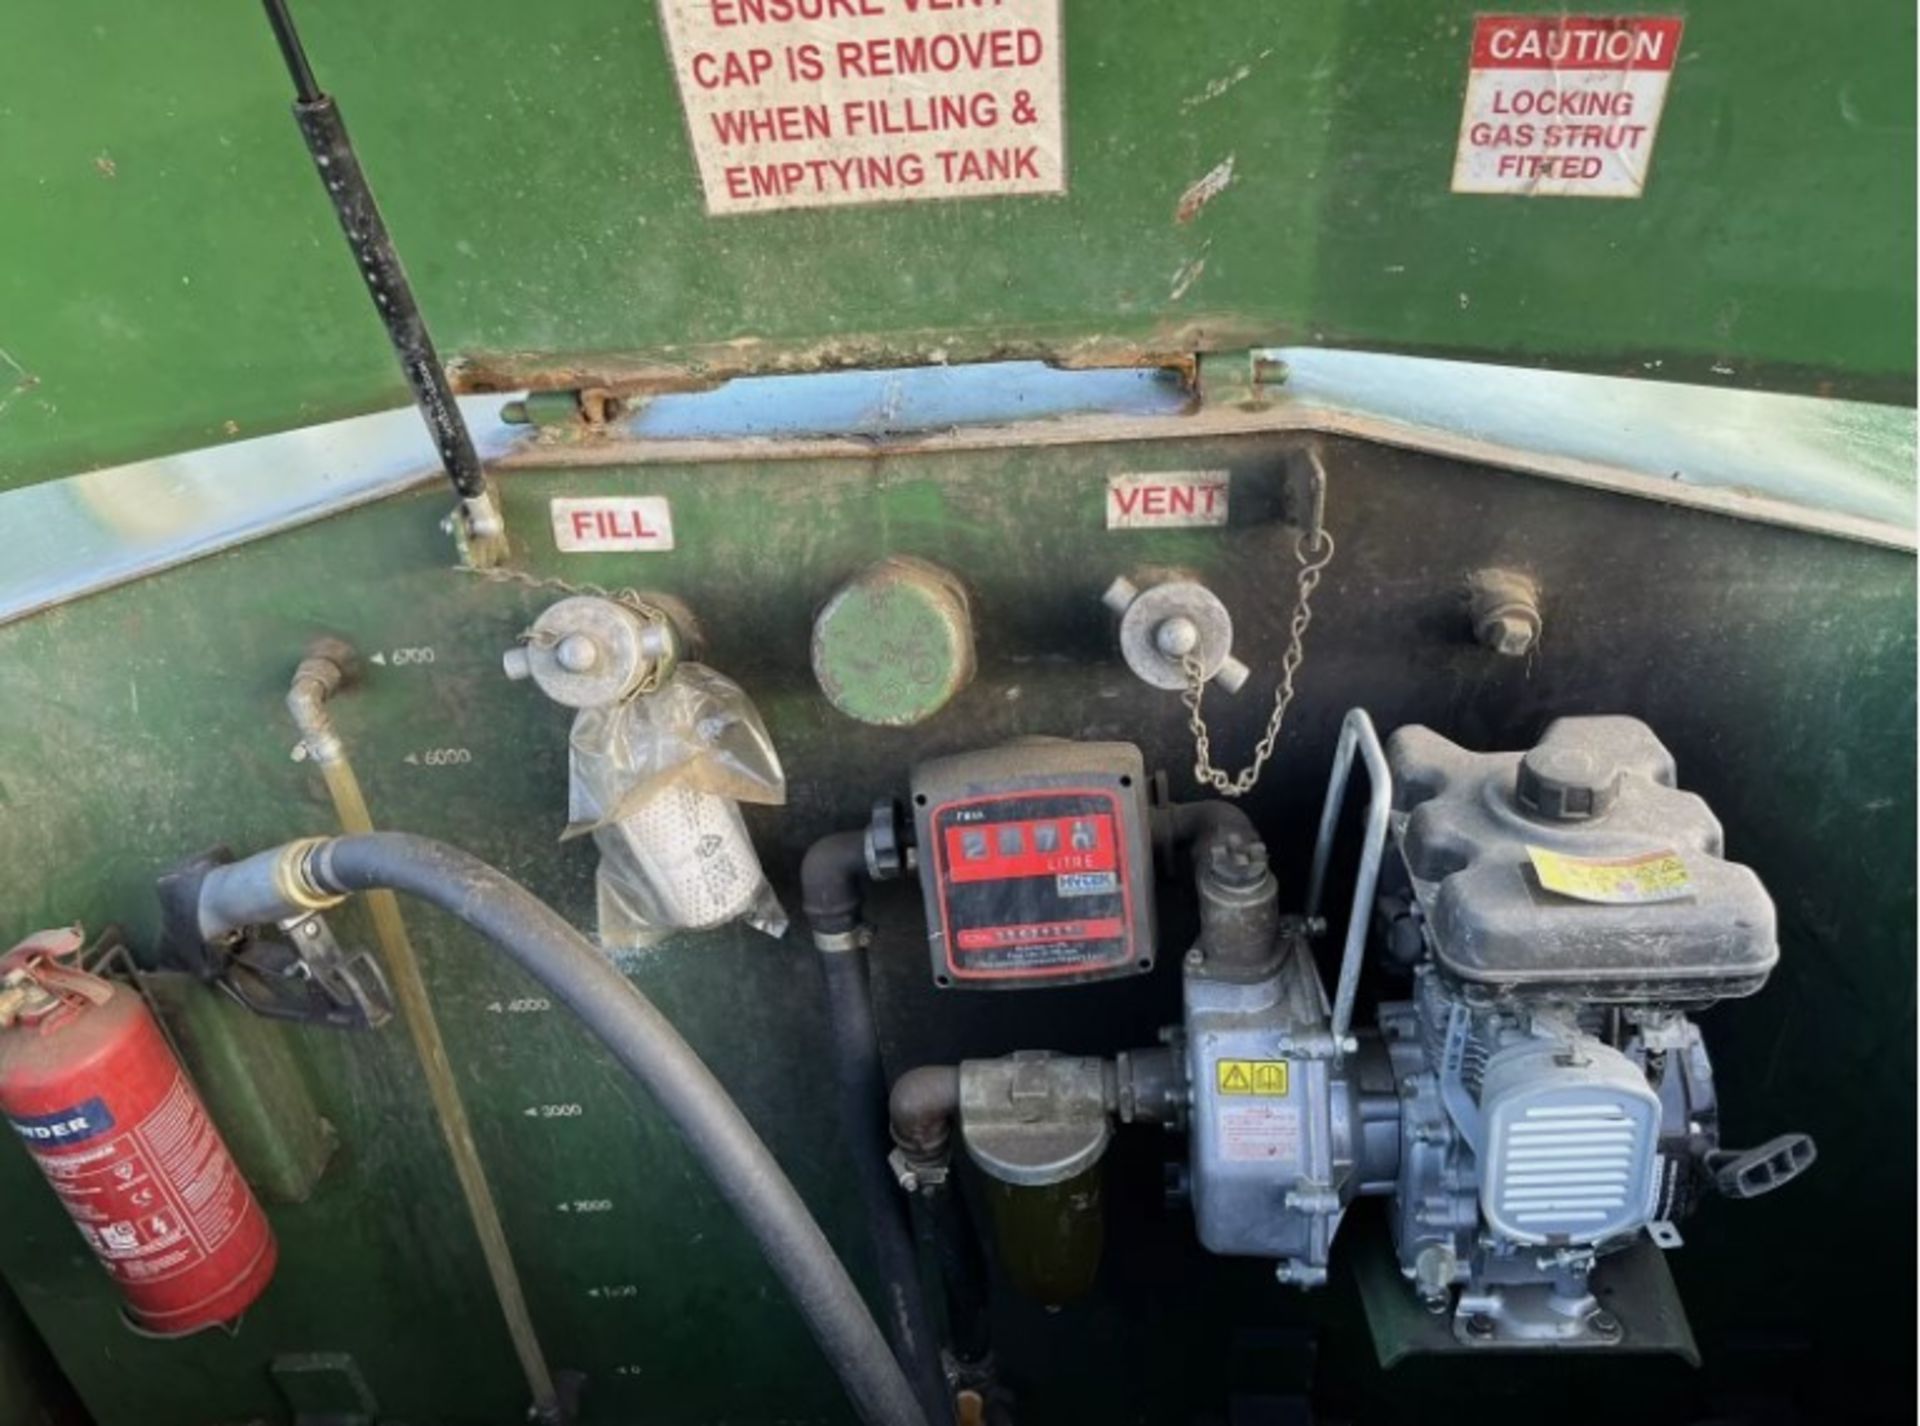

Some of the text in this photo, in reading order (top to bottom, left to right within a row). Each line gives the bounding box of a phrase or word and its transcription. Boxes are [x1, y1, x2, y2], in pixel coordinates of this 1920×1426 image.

[692, 29, 1043, 89] CAP IS REMOVED
[1490, 29, 1663, 61] CAUTION
[1492, 89, 1634, 116] LOCKING
[711, 90, 1038, 146] WHEN FILLING &
[1470, 122, 1647, 149] GAS STRUT
[724, 146, 1040, 199] EMPTYING TANK
[1498, 154, 1603, 179] FITTED
[1113, 484, 1226, 515] VENT
[571, 510, 658, 539] FILL
[425, 748, 472, 766] 6000
